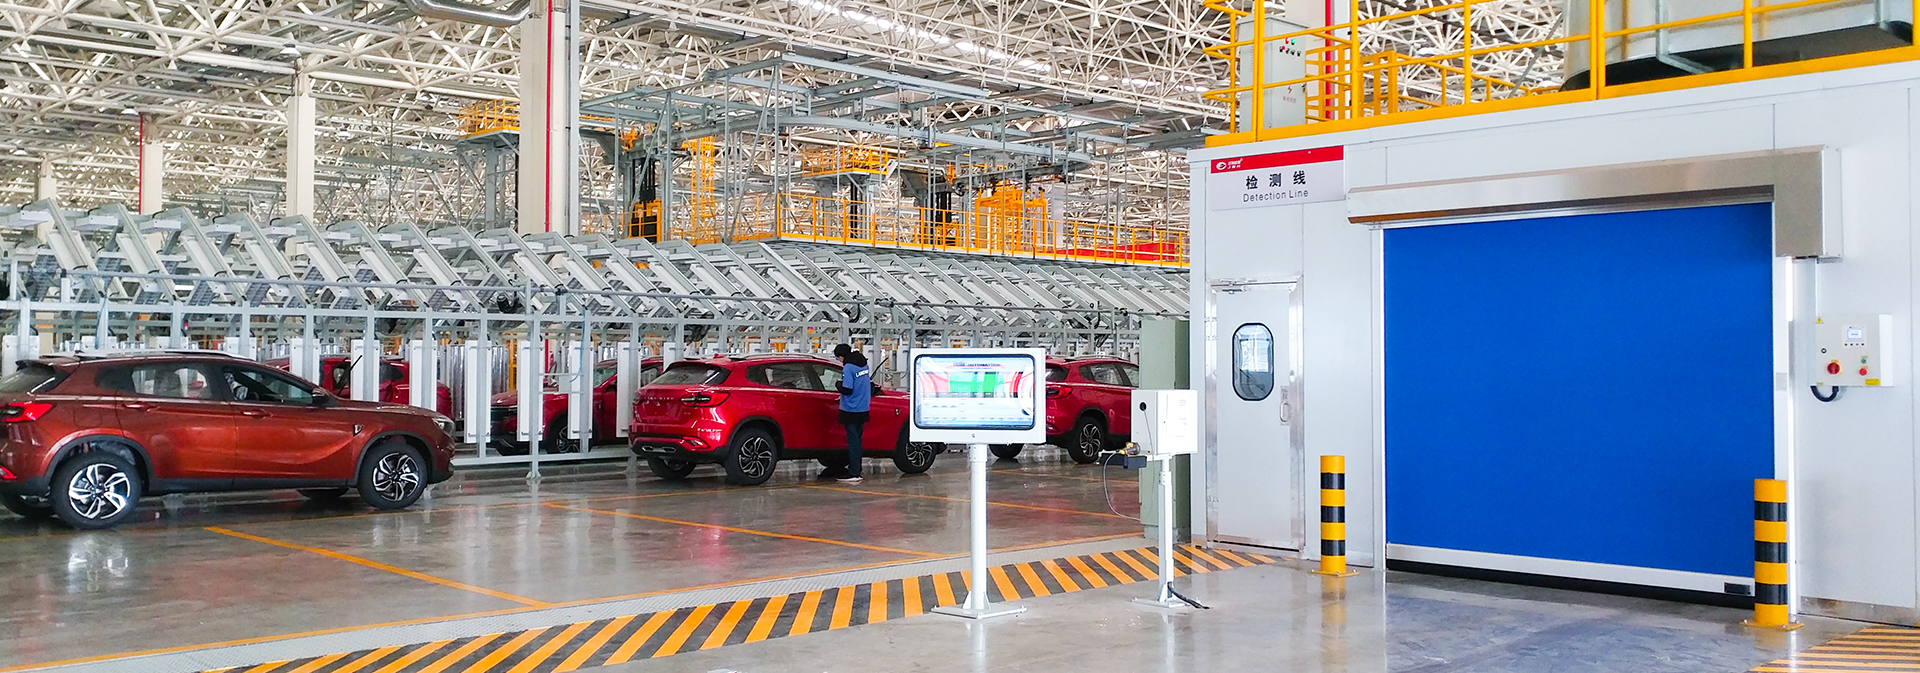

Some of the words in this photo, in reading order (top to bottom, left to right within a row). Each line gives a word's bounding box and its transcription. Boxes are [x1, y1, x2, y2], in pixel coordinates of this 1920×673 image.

[1245, 170, 1306, 190] 检测线
[1243, 191, 1287, 203] Detection
[1288, 188, 1309, 199] Line
